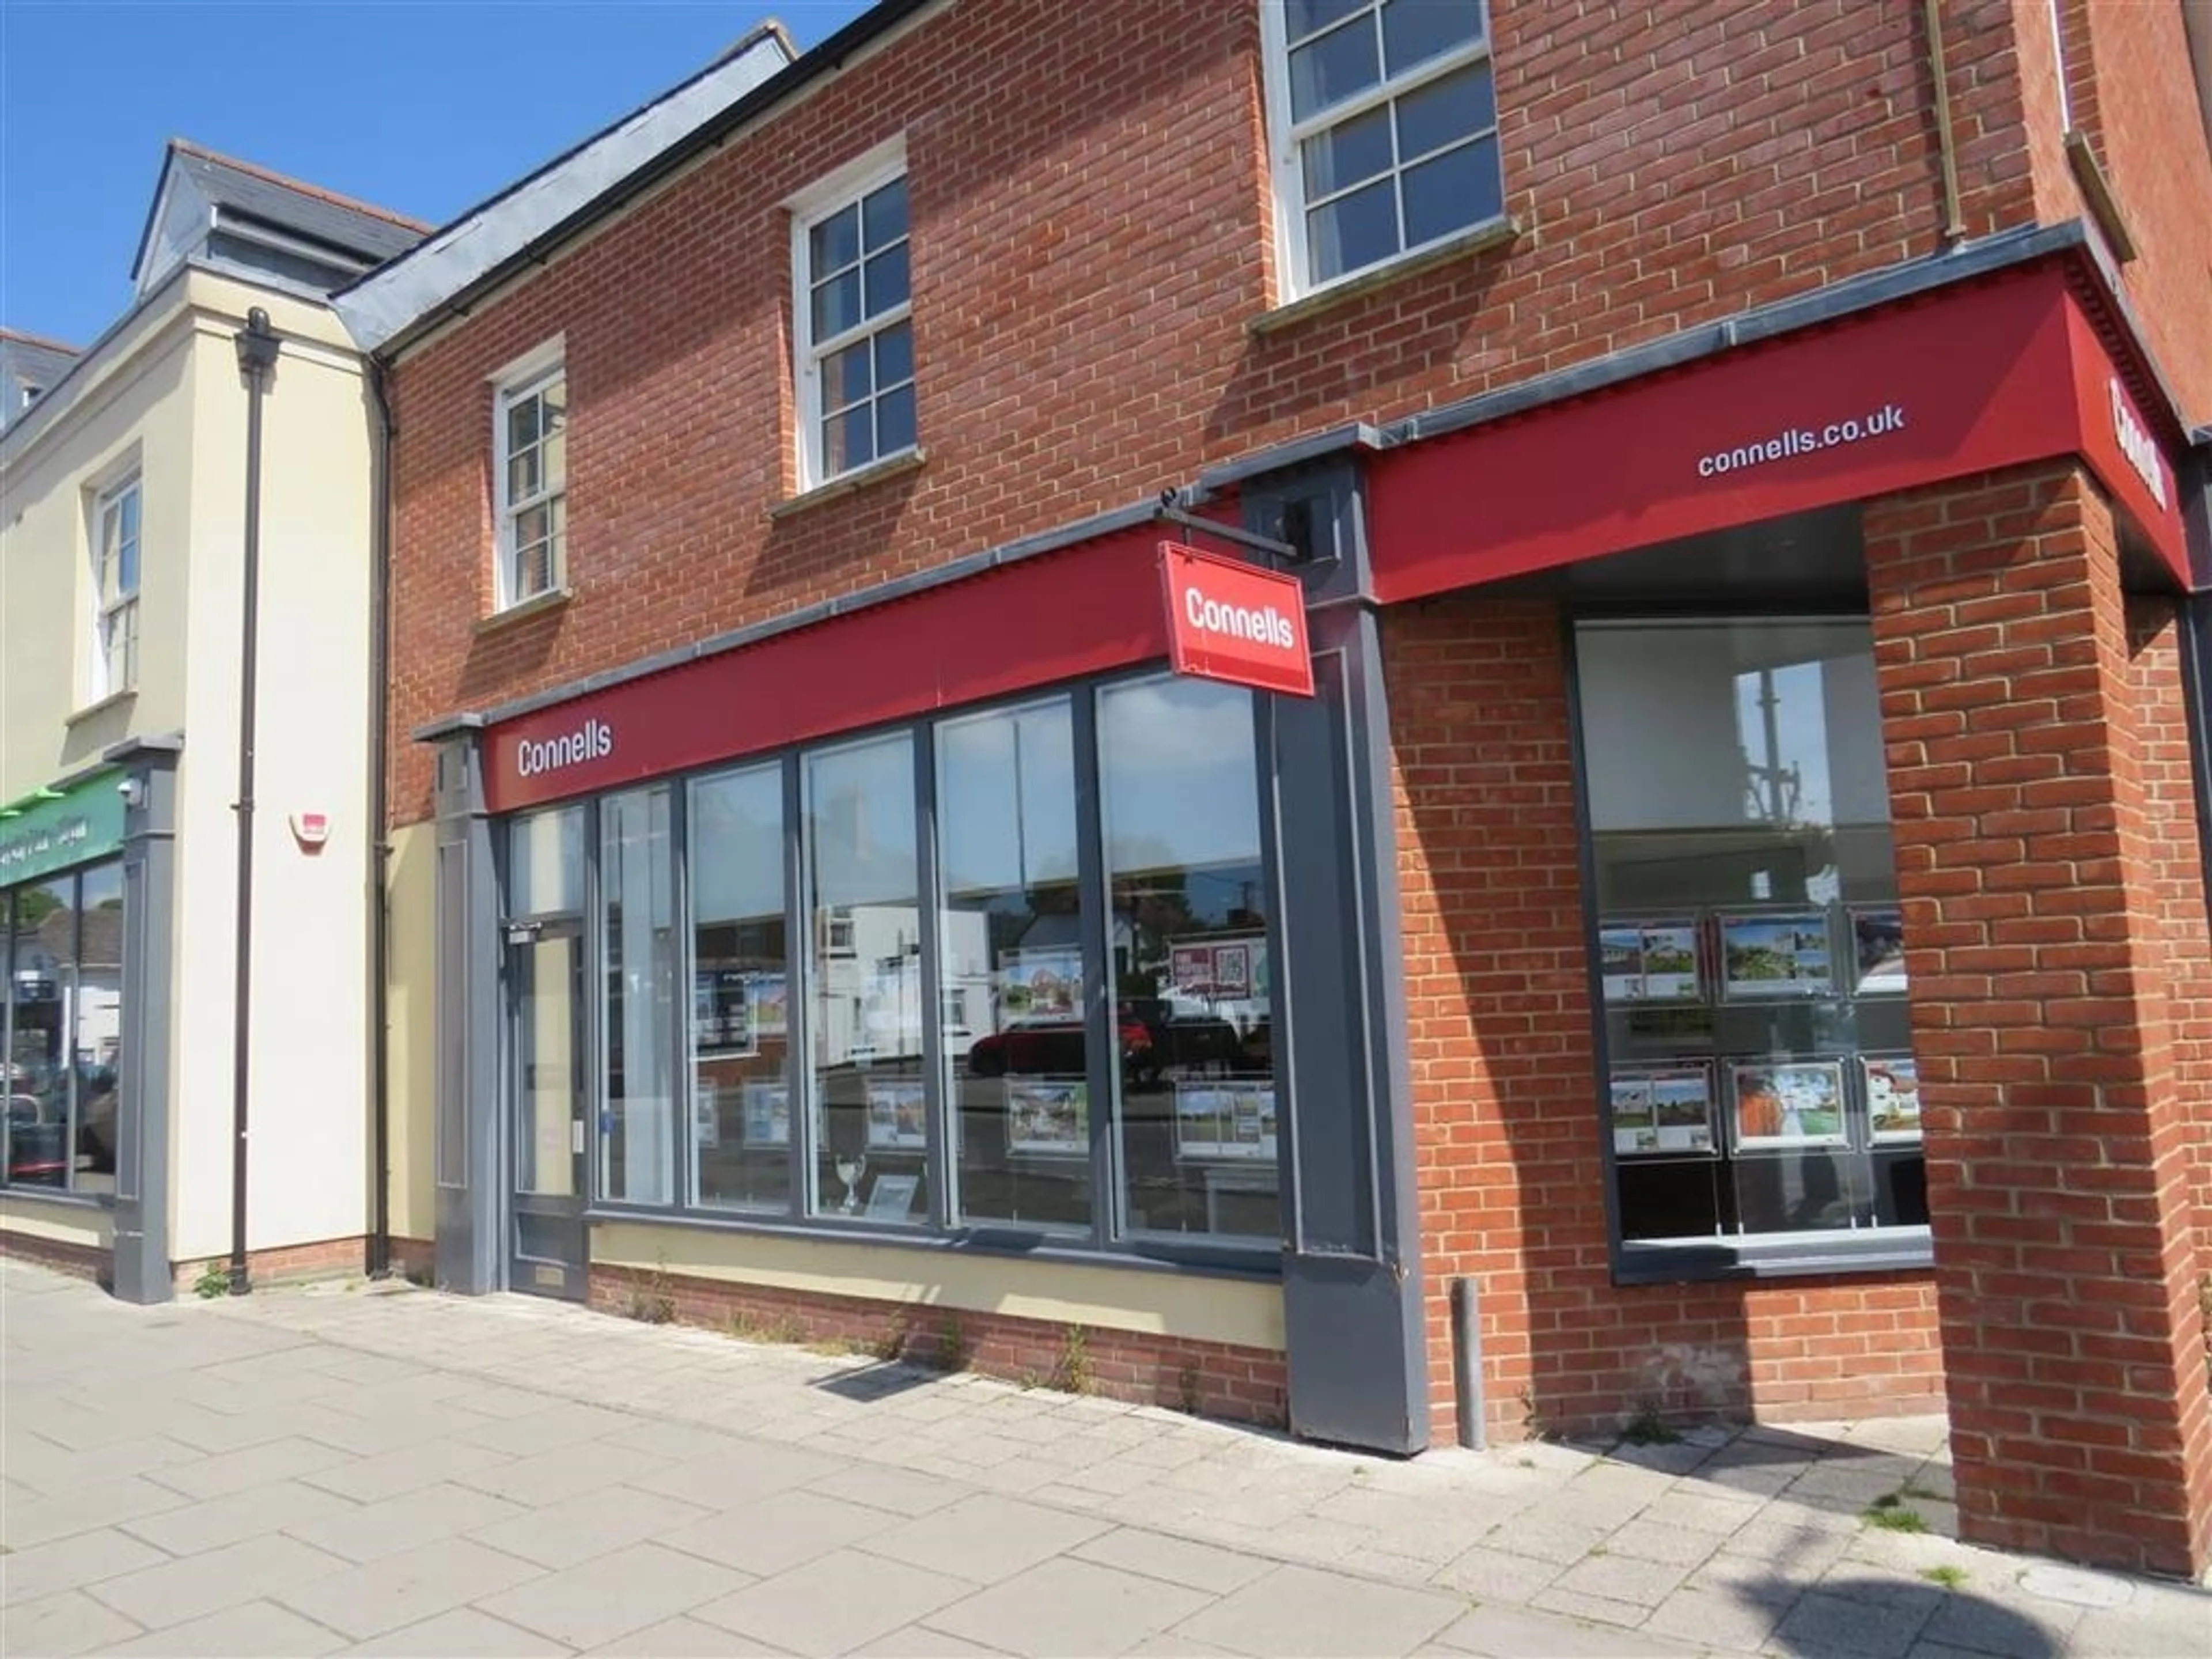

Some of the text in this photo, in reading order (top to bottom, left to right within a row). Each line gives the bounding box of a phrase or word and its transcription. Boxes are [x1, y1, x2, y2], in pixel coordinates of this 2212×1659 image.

[1699, 406, 1904, 476] connells.co.uk
[1185, 586, 1294, 649] Connells
[519, 719, 611, 776] Connells
